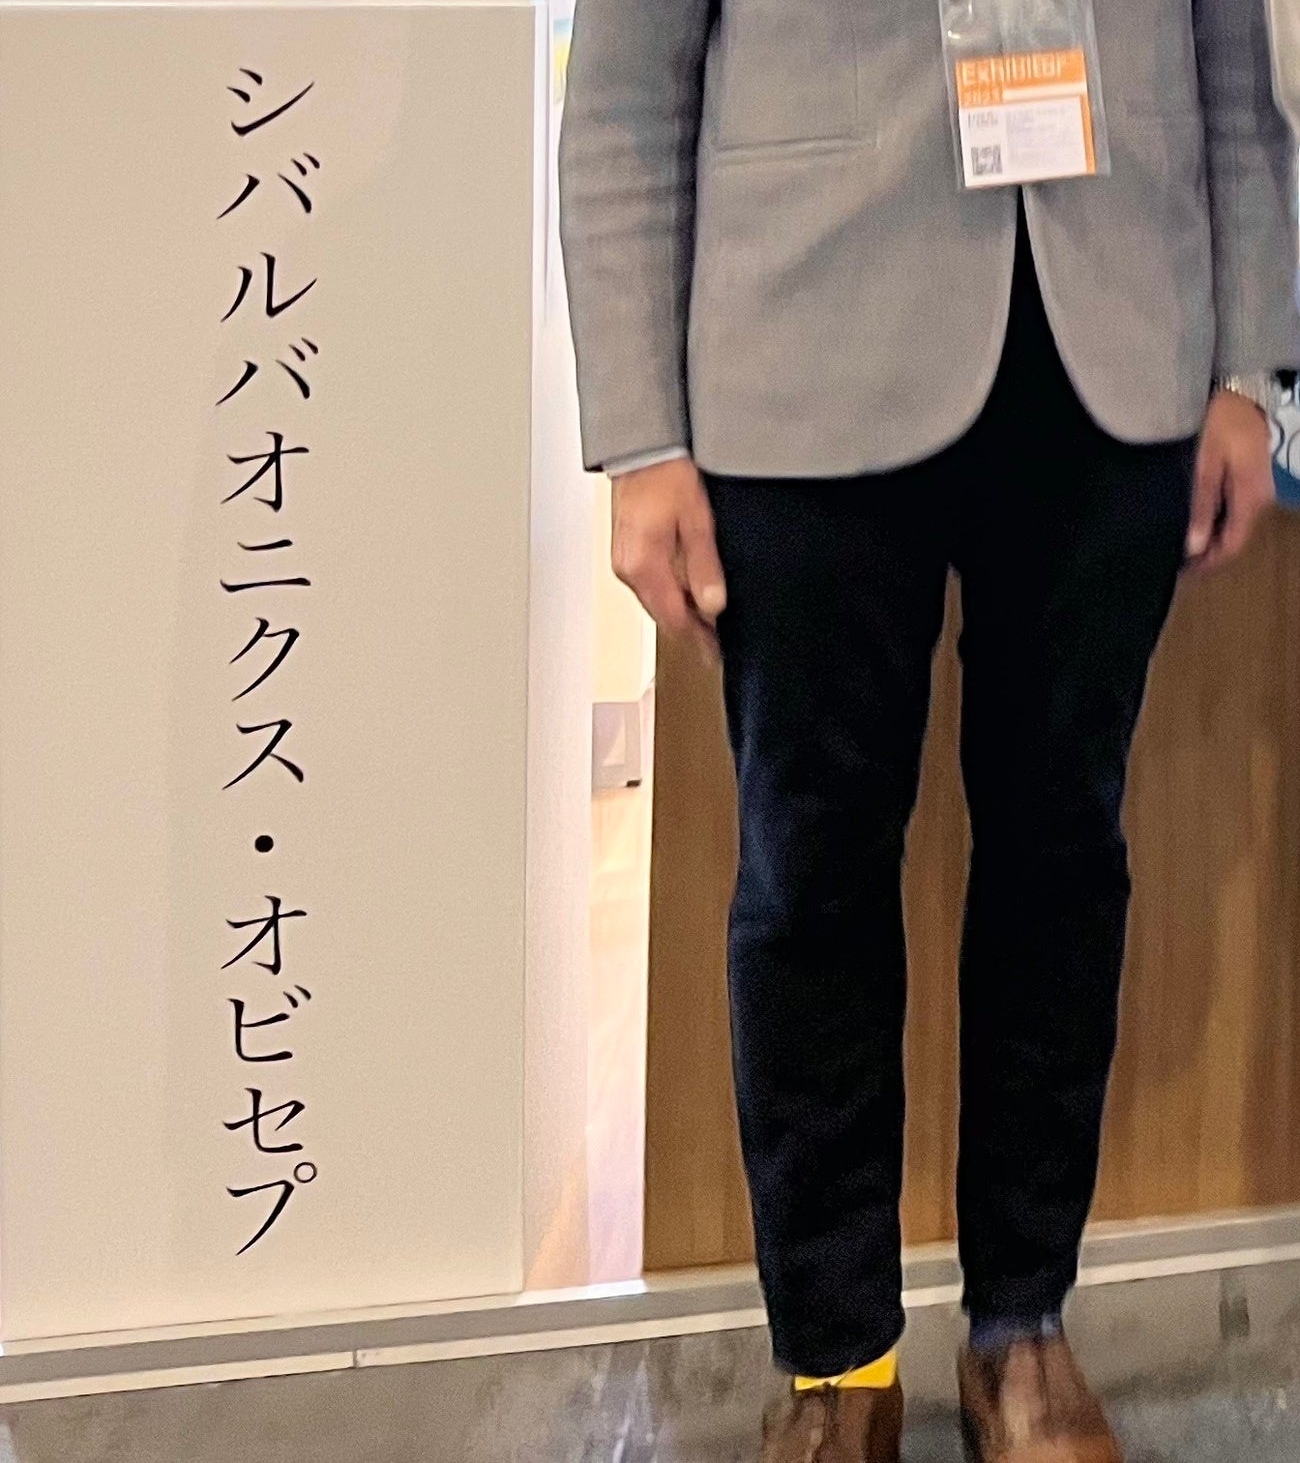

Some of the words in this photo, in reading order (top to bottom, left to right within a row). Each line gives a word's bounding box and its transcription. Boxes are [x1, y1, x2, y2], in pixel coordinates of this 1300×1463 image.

[215, 67, 321, 1257] シバルバオニクス・オビセプ
